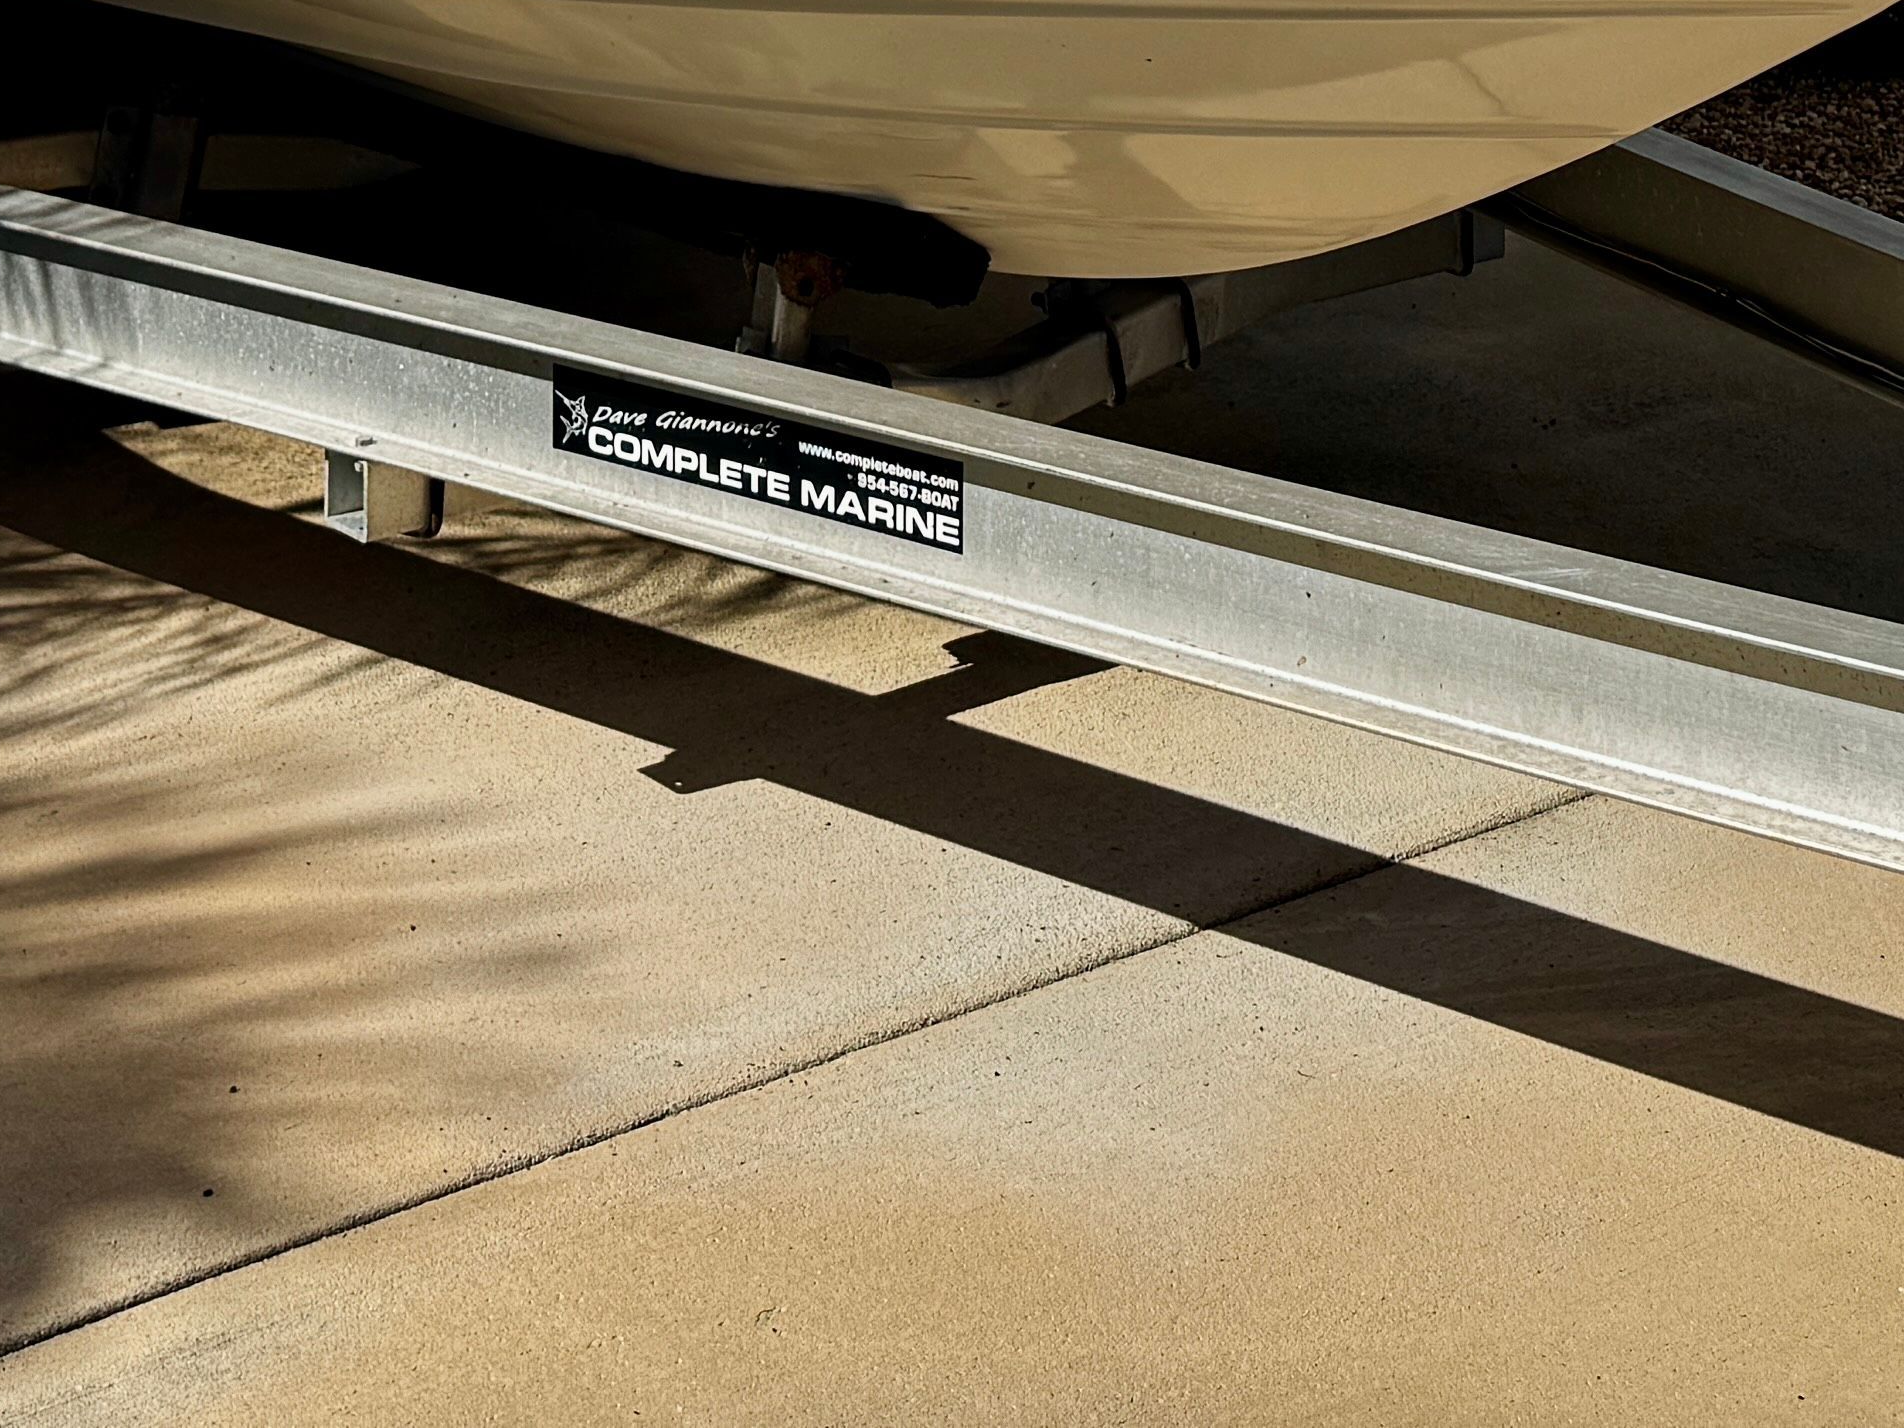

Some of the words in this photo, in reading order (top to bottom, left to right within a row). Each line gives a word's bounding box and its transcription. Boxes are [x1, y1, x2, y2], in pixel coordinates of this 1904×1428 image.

[592, 405, 647, 427] Dave
[655, 410, 781, 438] Giannone's
[587, 425, 791, 502] COMPLETE
[800, 478, 960, 546] MARINE
[798, 440, 959, 492] www.completeboat.com
[857, 472, 960, 512] 954-567-BOAT
